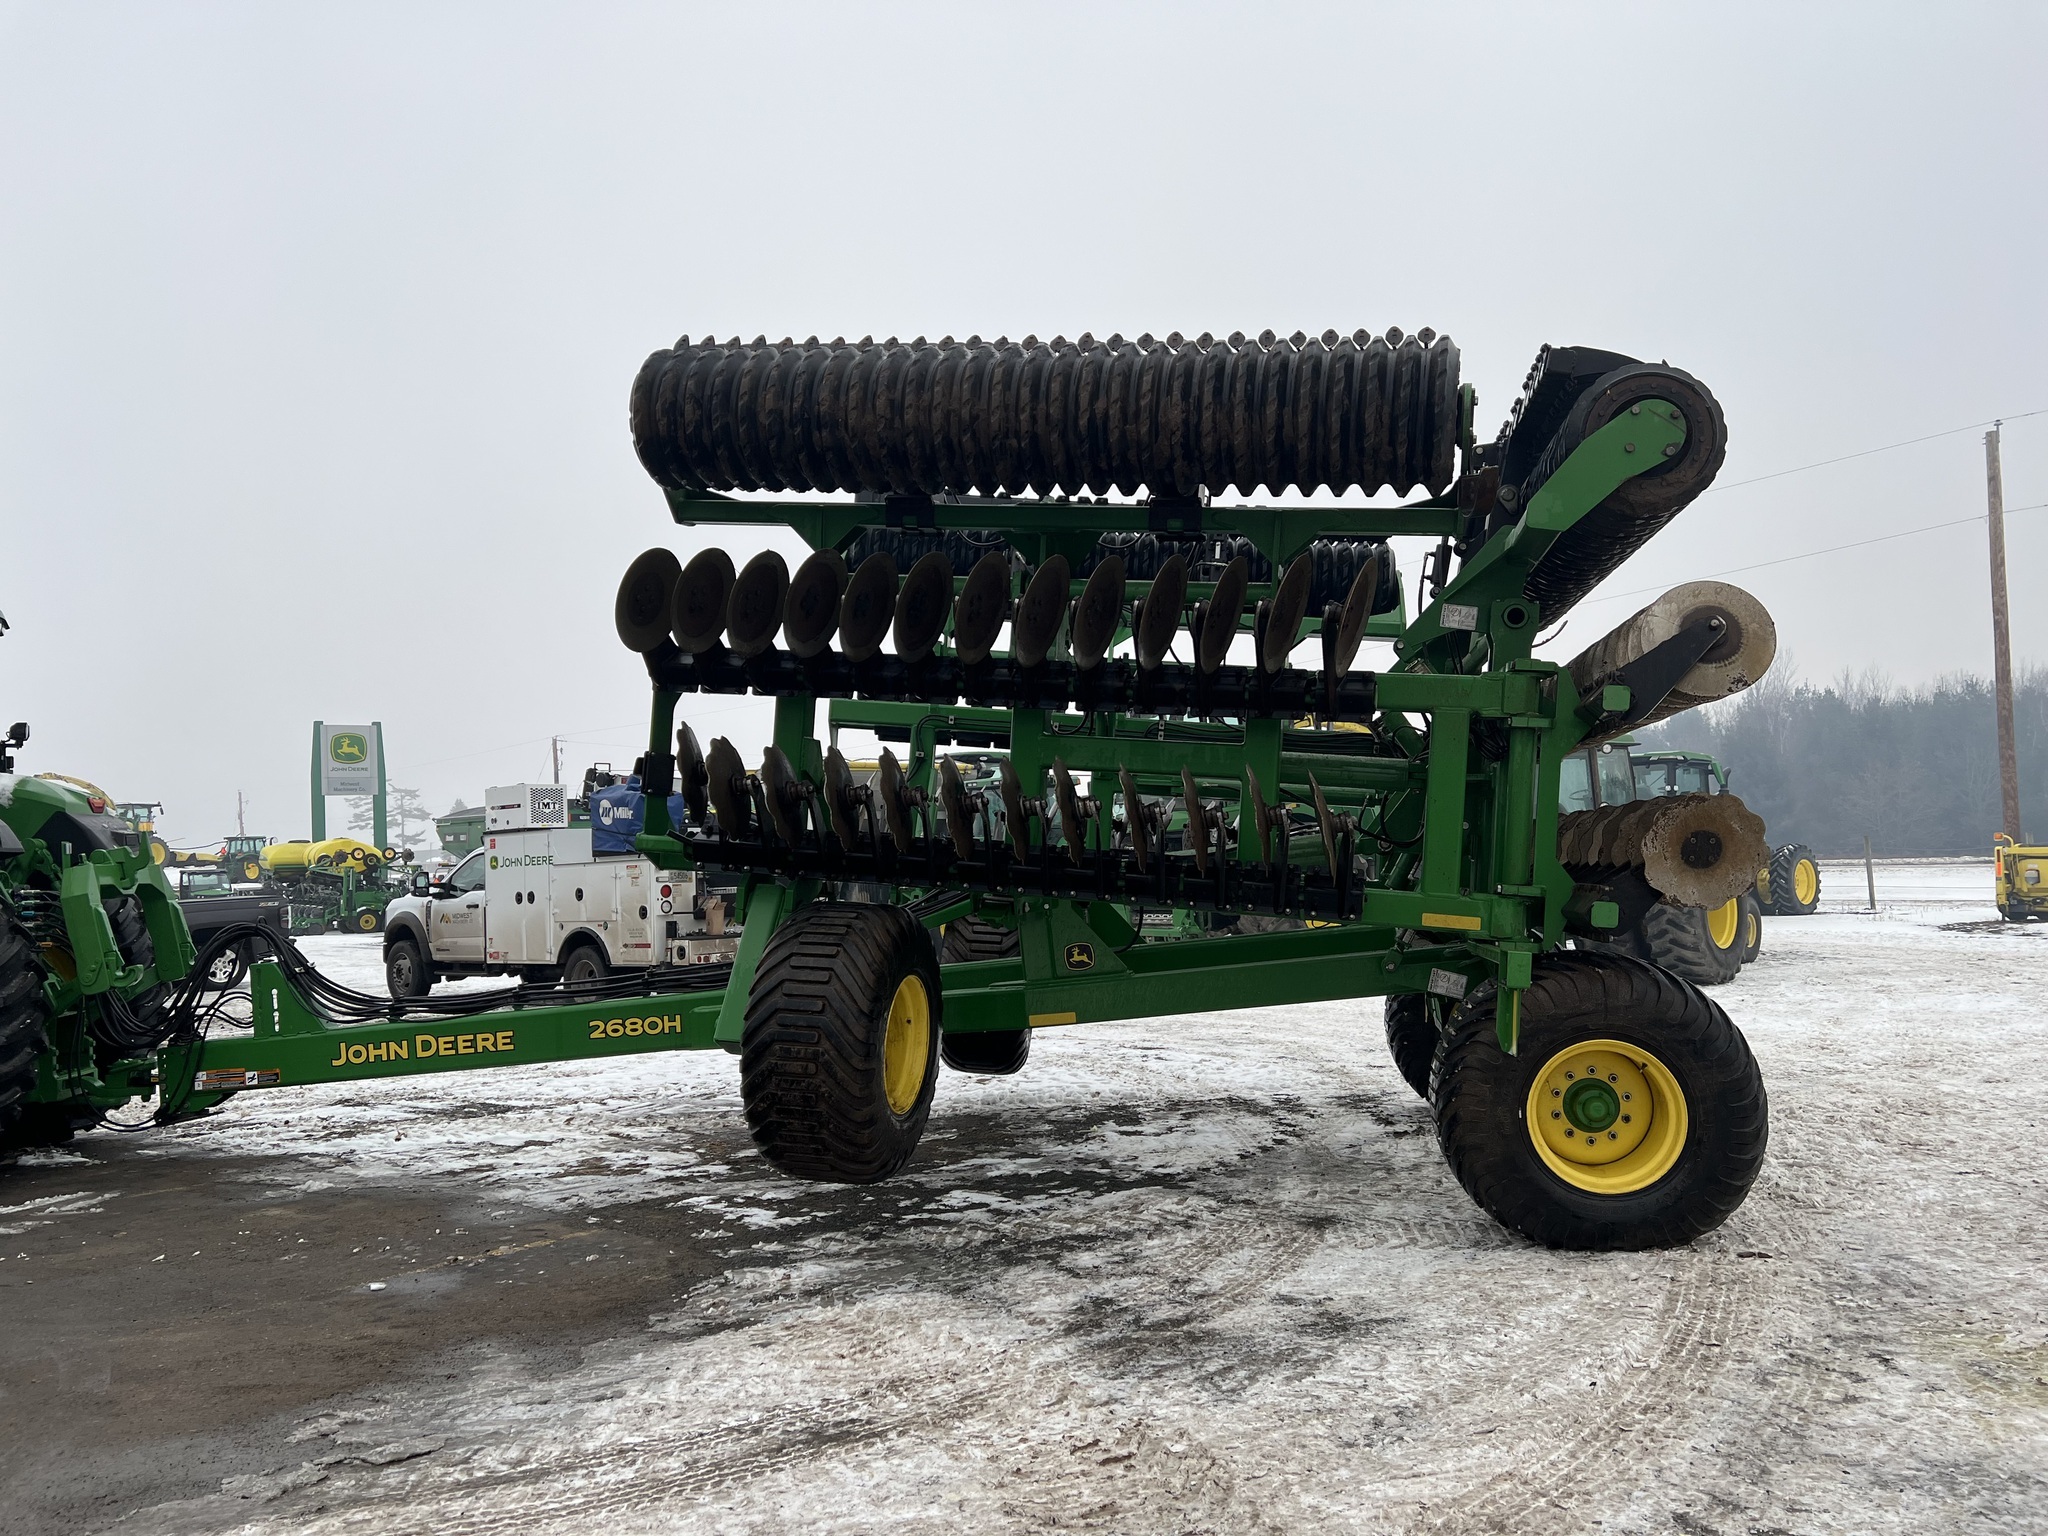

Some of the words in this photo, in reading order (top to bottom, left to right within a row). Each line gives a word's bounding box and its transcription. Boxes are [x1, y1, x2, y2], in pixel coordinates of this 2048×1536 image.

[536, 802, 558, 810] IMT
[500, 856, 523, 868] JOHN
[524, 854, 554, 867] DEERE
[588, 1013, 682, 1039] 2680H
[331, 1040, 409, 1067] JOHN
[414, 1030, 515, 1059] DEERE
